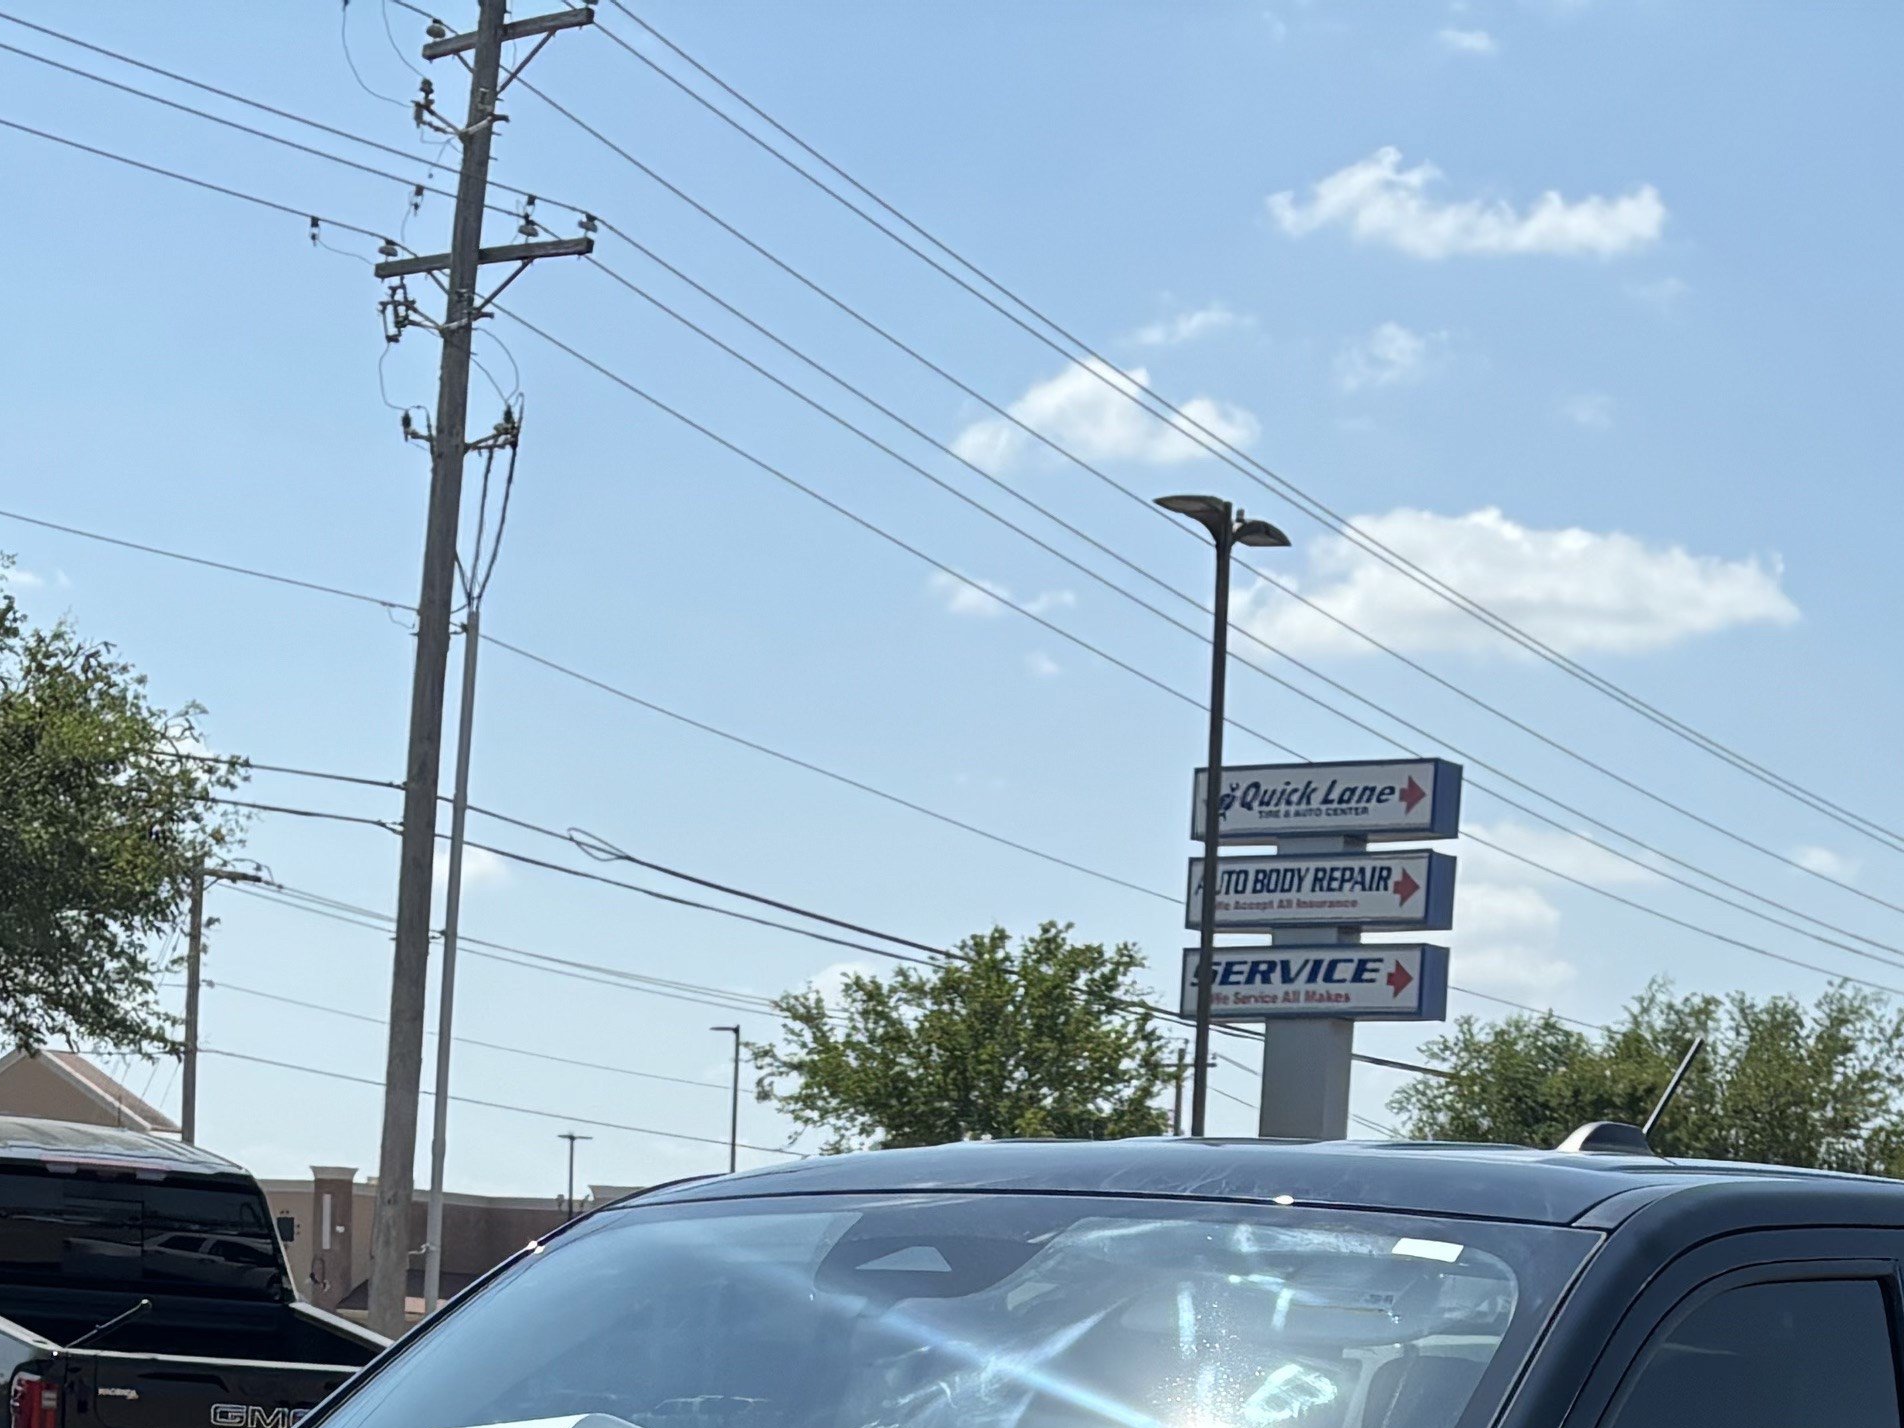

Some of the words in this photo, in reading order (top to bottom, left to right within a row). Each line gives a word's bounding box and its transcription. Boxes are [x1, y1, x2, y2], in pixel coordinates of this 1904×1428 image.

[1241, 779, 1318, 811] Quick
[1319, 779, 1396, 806] Lane
[1252, 867, 1309, 894] BODY
[1310, 866, 1393, 893] REPAIR
